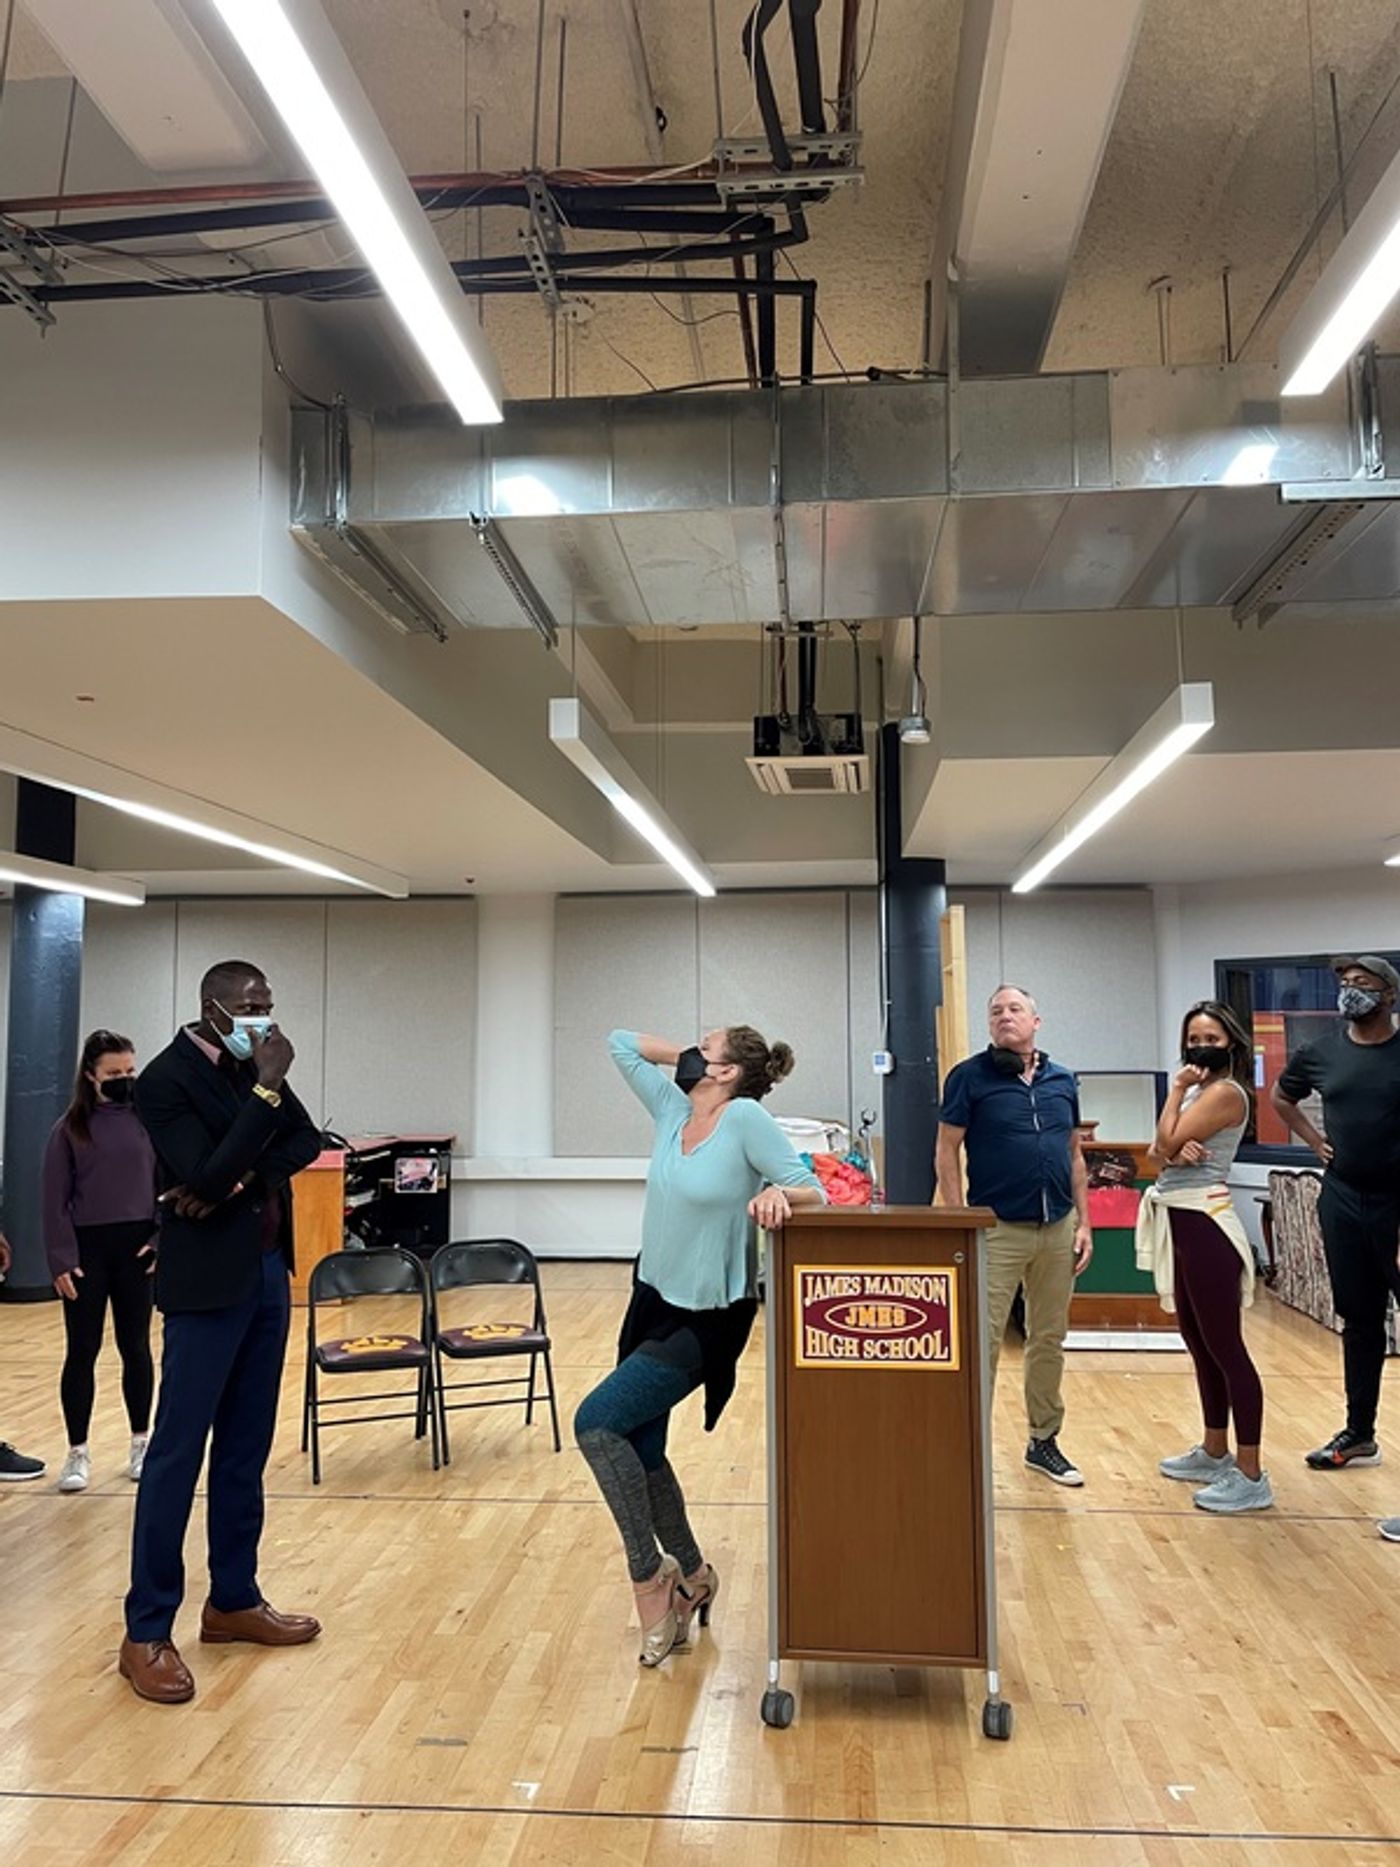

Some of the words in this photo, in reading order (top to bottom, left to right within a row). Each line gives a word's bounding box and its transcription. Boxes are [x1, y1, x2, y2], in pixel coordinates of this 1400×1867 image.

[804, 1275, 862, 1307] JAMES
[864, 1276, 947, 1307] MADISON
[805, 1325, 860, 1358] HIGH
[863, 1329, 948, 1360] SCHOOL
